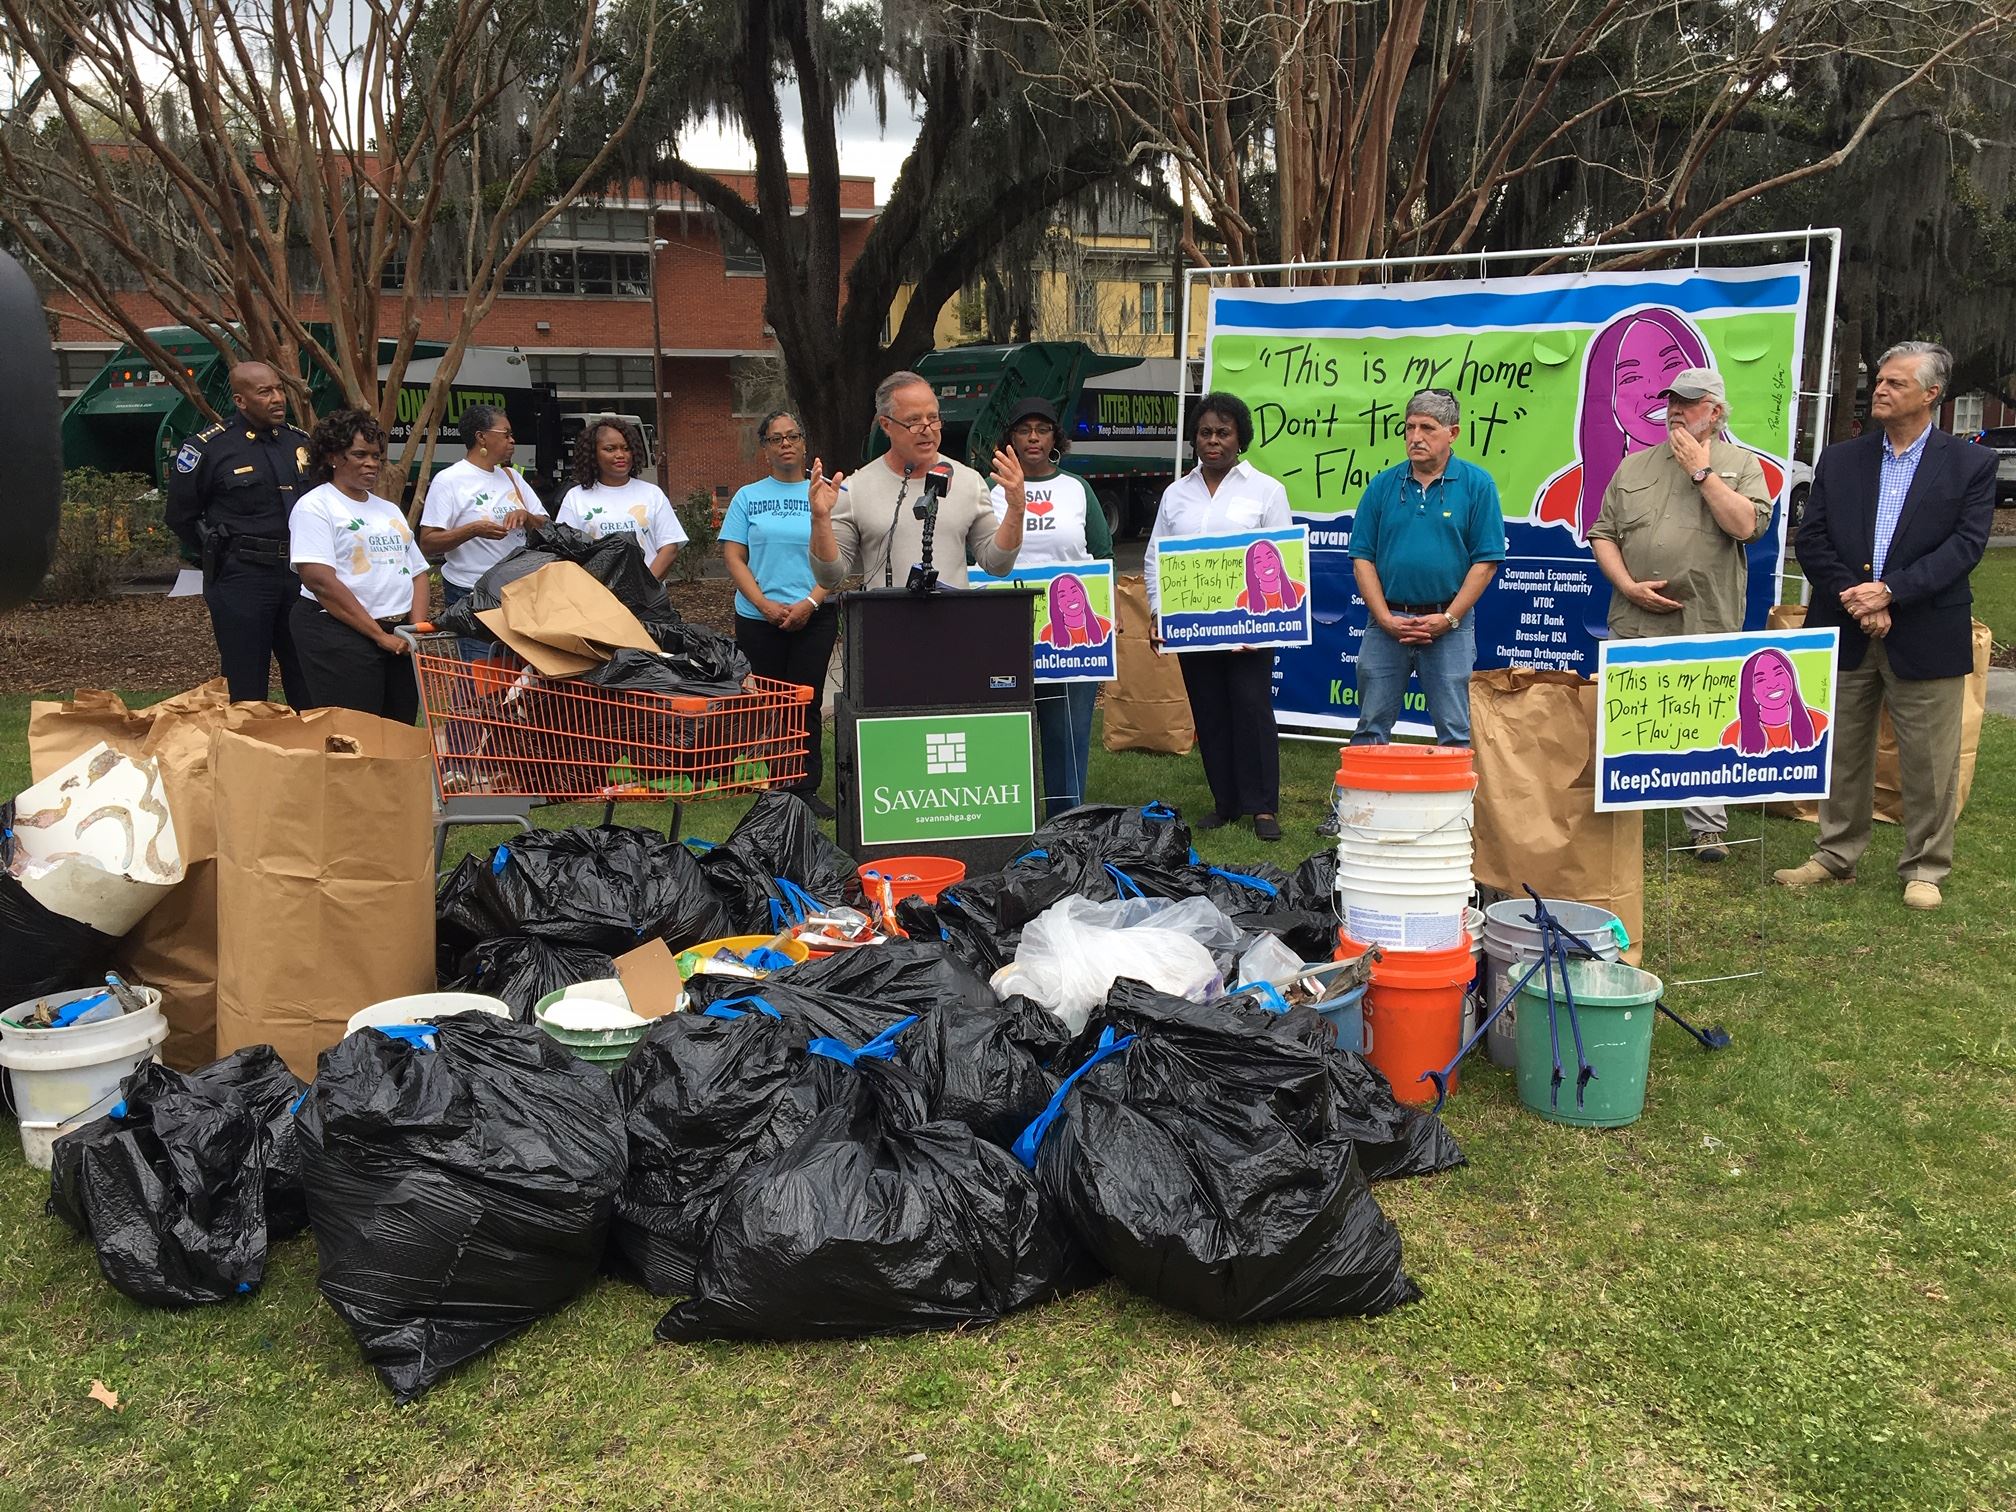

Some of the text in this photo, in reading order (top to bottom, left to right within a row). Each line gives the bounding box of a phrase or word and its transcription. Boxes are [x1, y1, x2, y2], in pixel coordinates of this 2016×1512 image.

[1363, 351, 1386, 384] is
[1402, 356, 1452, 390] my
[1457, 340, 1533, 395] home.
[1098, 394, 1130, 423] LITTER
[1132, 395, 1161, 423] COSTS
[1254, 403, 1338, 448] Don't
[1359, 399, 1406, 446] tra
[1098, 426, 1111, 436] Keep
[1113, 426, 1135, 434] Savannah
[1158, 426, 1166, 434] and
[1026, 490, 1052, 502] SAV
[748, 499, 810, 516] GEORGIA SOUTH
[772, 509, 801, 518] Eagles
[600, 520, 635, 530] GREAT
[1026, 517, 1056, 531] BIZ
[369, 535, 400, 545] GREAT
[1193, 558, 1200, 568] is
[1205, 558, 1219, 570] my
[1505, 568, 1588, 582] Savannah Economic
[1161, 575, 1187, 592] Don't
[1498, 579, 1592, 596] Development Authority
[1533, 597, 1555, 608] WTOC
[1521, 613, 1564, 626] BB&T Bank
[1167, 619, 1302, 641] KeepSavannahClean.com
[1516, 630, 1567, 643] Brassler USA
[1496, 645, 1584, 662] Chatham Orthopaedic
[1559, 660, 1569, 671] PA
[1658, 671, 1670, 688] is
[1678, 672, 1700, 690] my
[1607, 698, 1647, 722] Don't
[1610, 764, 1817, 793] KeepSavannahClean.com
[874, 784, 1020, 815] SAVANNAH
[916, 813, 982, 823] savannahga.gov
